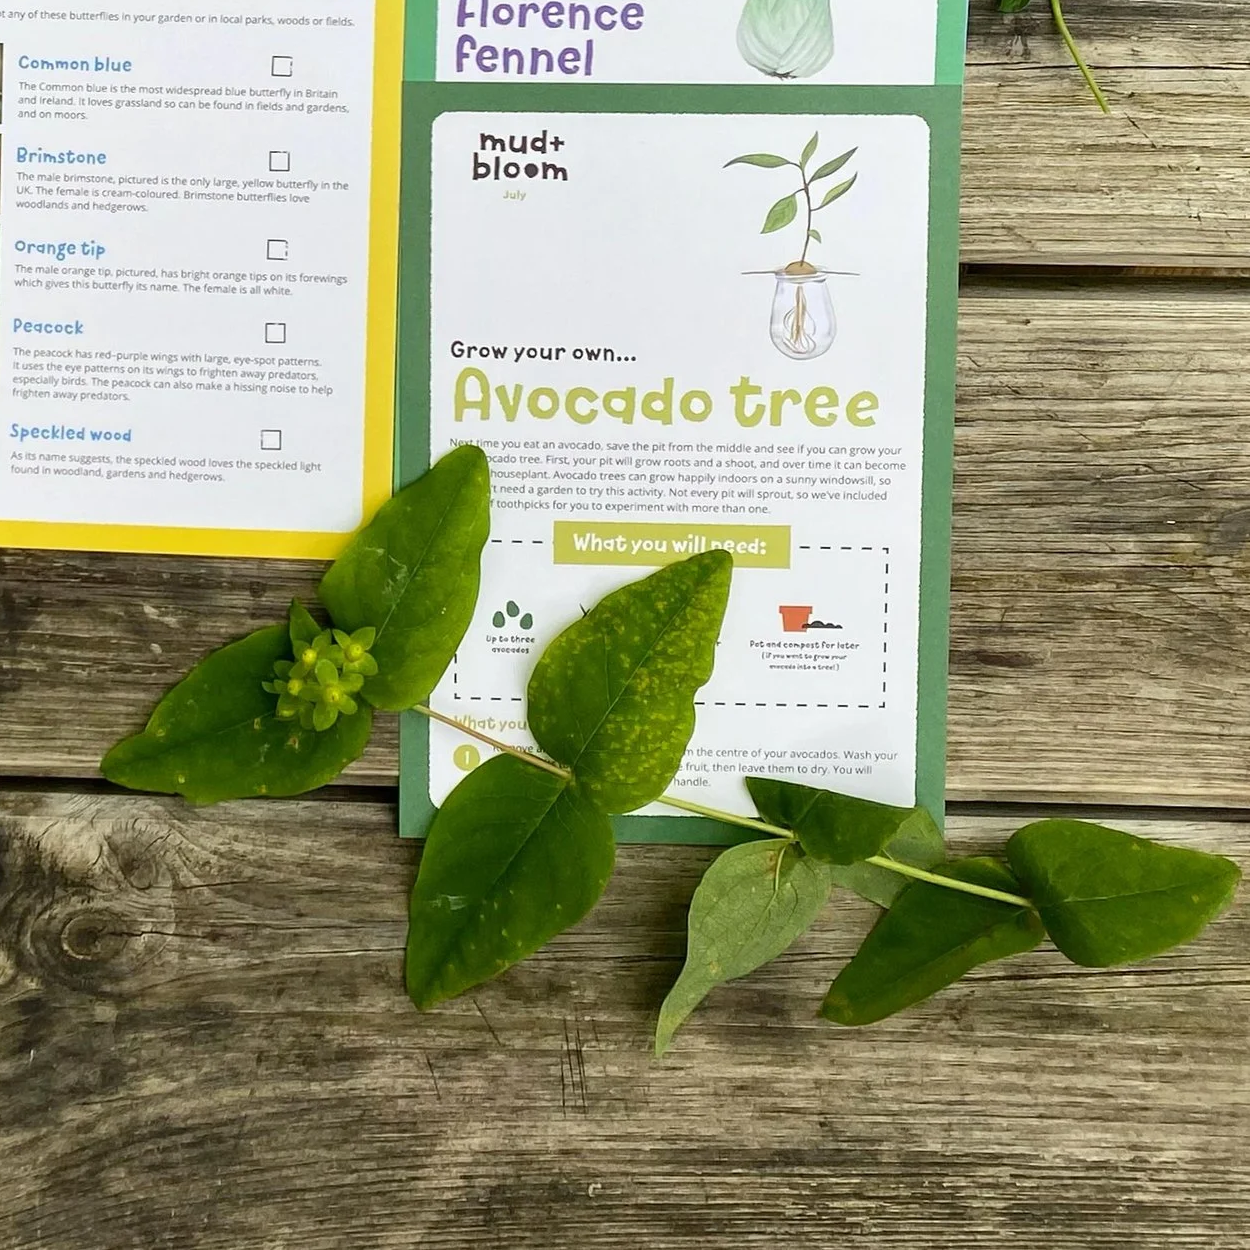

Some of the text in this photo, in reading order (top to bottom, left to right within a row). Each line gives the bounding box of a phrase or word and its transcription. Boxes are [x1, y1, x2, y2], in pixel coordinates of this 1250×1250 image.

[18, 55, 132, 72] Common blue
[456, 34, 593, 75] fennel
[18, 110, 36, 118] and
[477, 130, 565, 154] mud+
[16, 146, 106, 164] Brimstone
[472, 152, 568, 181] bloom
[502, 189, 526, 201] July
[14, 240, 106, 261] Orange tip
[13, 318, 84, 334] Peacock
[450, 340, 636, 362] Grow your own...
[453, 368, 879, 427] Avocado tree
[9, 423, 132, 442] Speckled wood
[573, 533, 767, 555] What you will need:
[485, 635, 497, 644] Up
[510, 635, 535, 643] three
[491, 646, 529, 654] avocados
